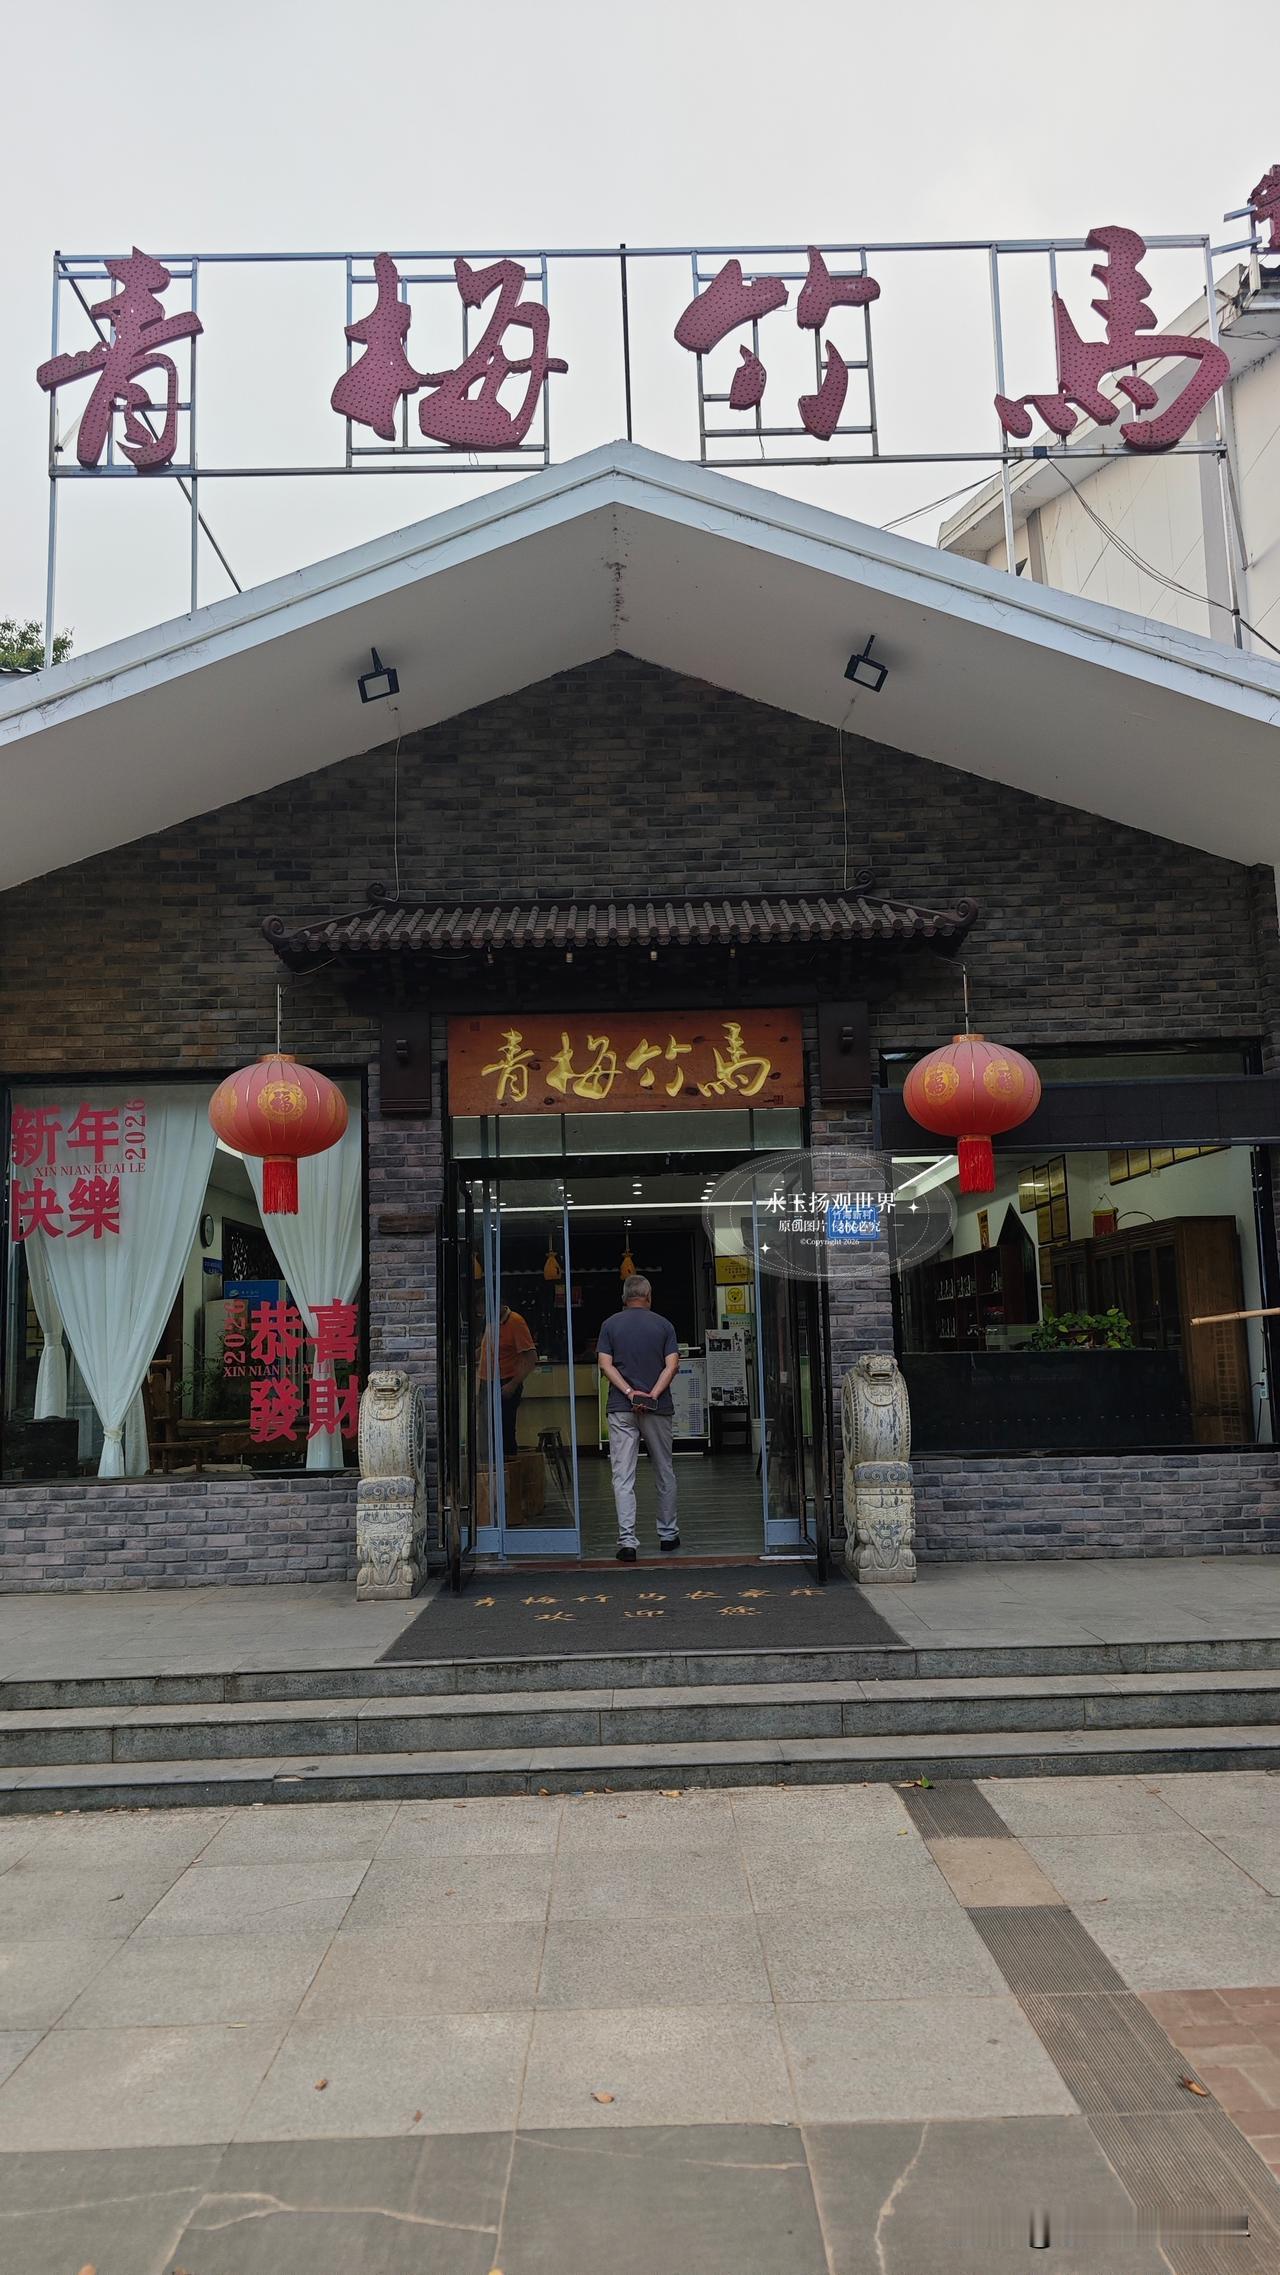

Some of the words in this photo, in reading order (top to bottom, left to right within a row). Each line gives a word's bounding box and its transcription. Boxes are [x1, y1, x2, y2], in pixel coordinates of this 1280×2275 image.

[12, 1102, 120, 1167] 新年
[125, 1098, 146, 1161] 2026
[35, 1166, 57, 1178] XIN
[60, 1164, 91, 1177] NIAN
[94, 1163, 125, 1175] KUAI
[130, 1162, 146, 1173] LE
[11, 1175, 120, 1242] 快樂
[250, 1298, 360, 1365] 恭喜
[223, 1366, 246, 1377] XIN
[249, 1365, 280, 1377] NIAN
[250, 1375, 360, 1442] 發財
